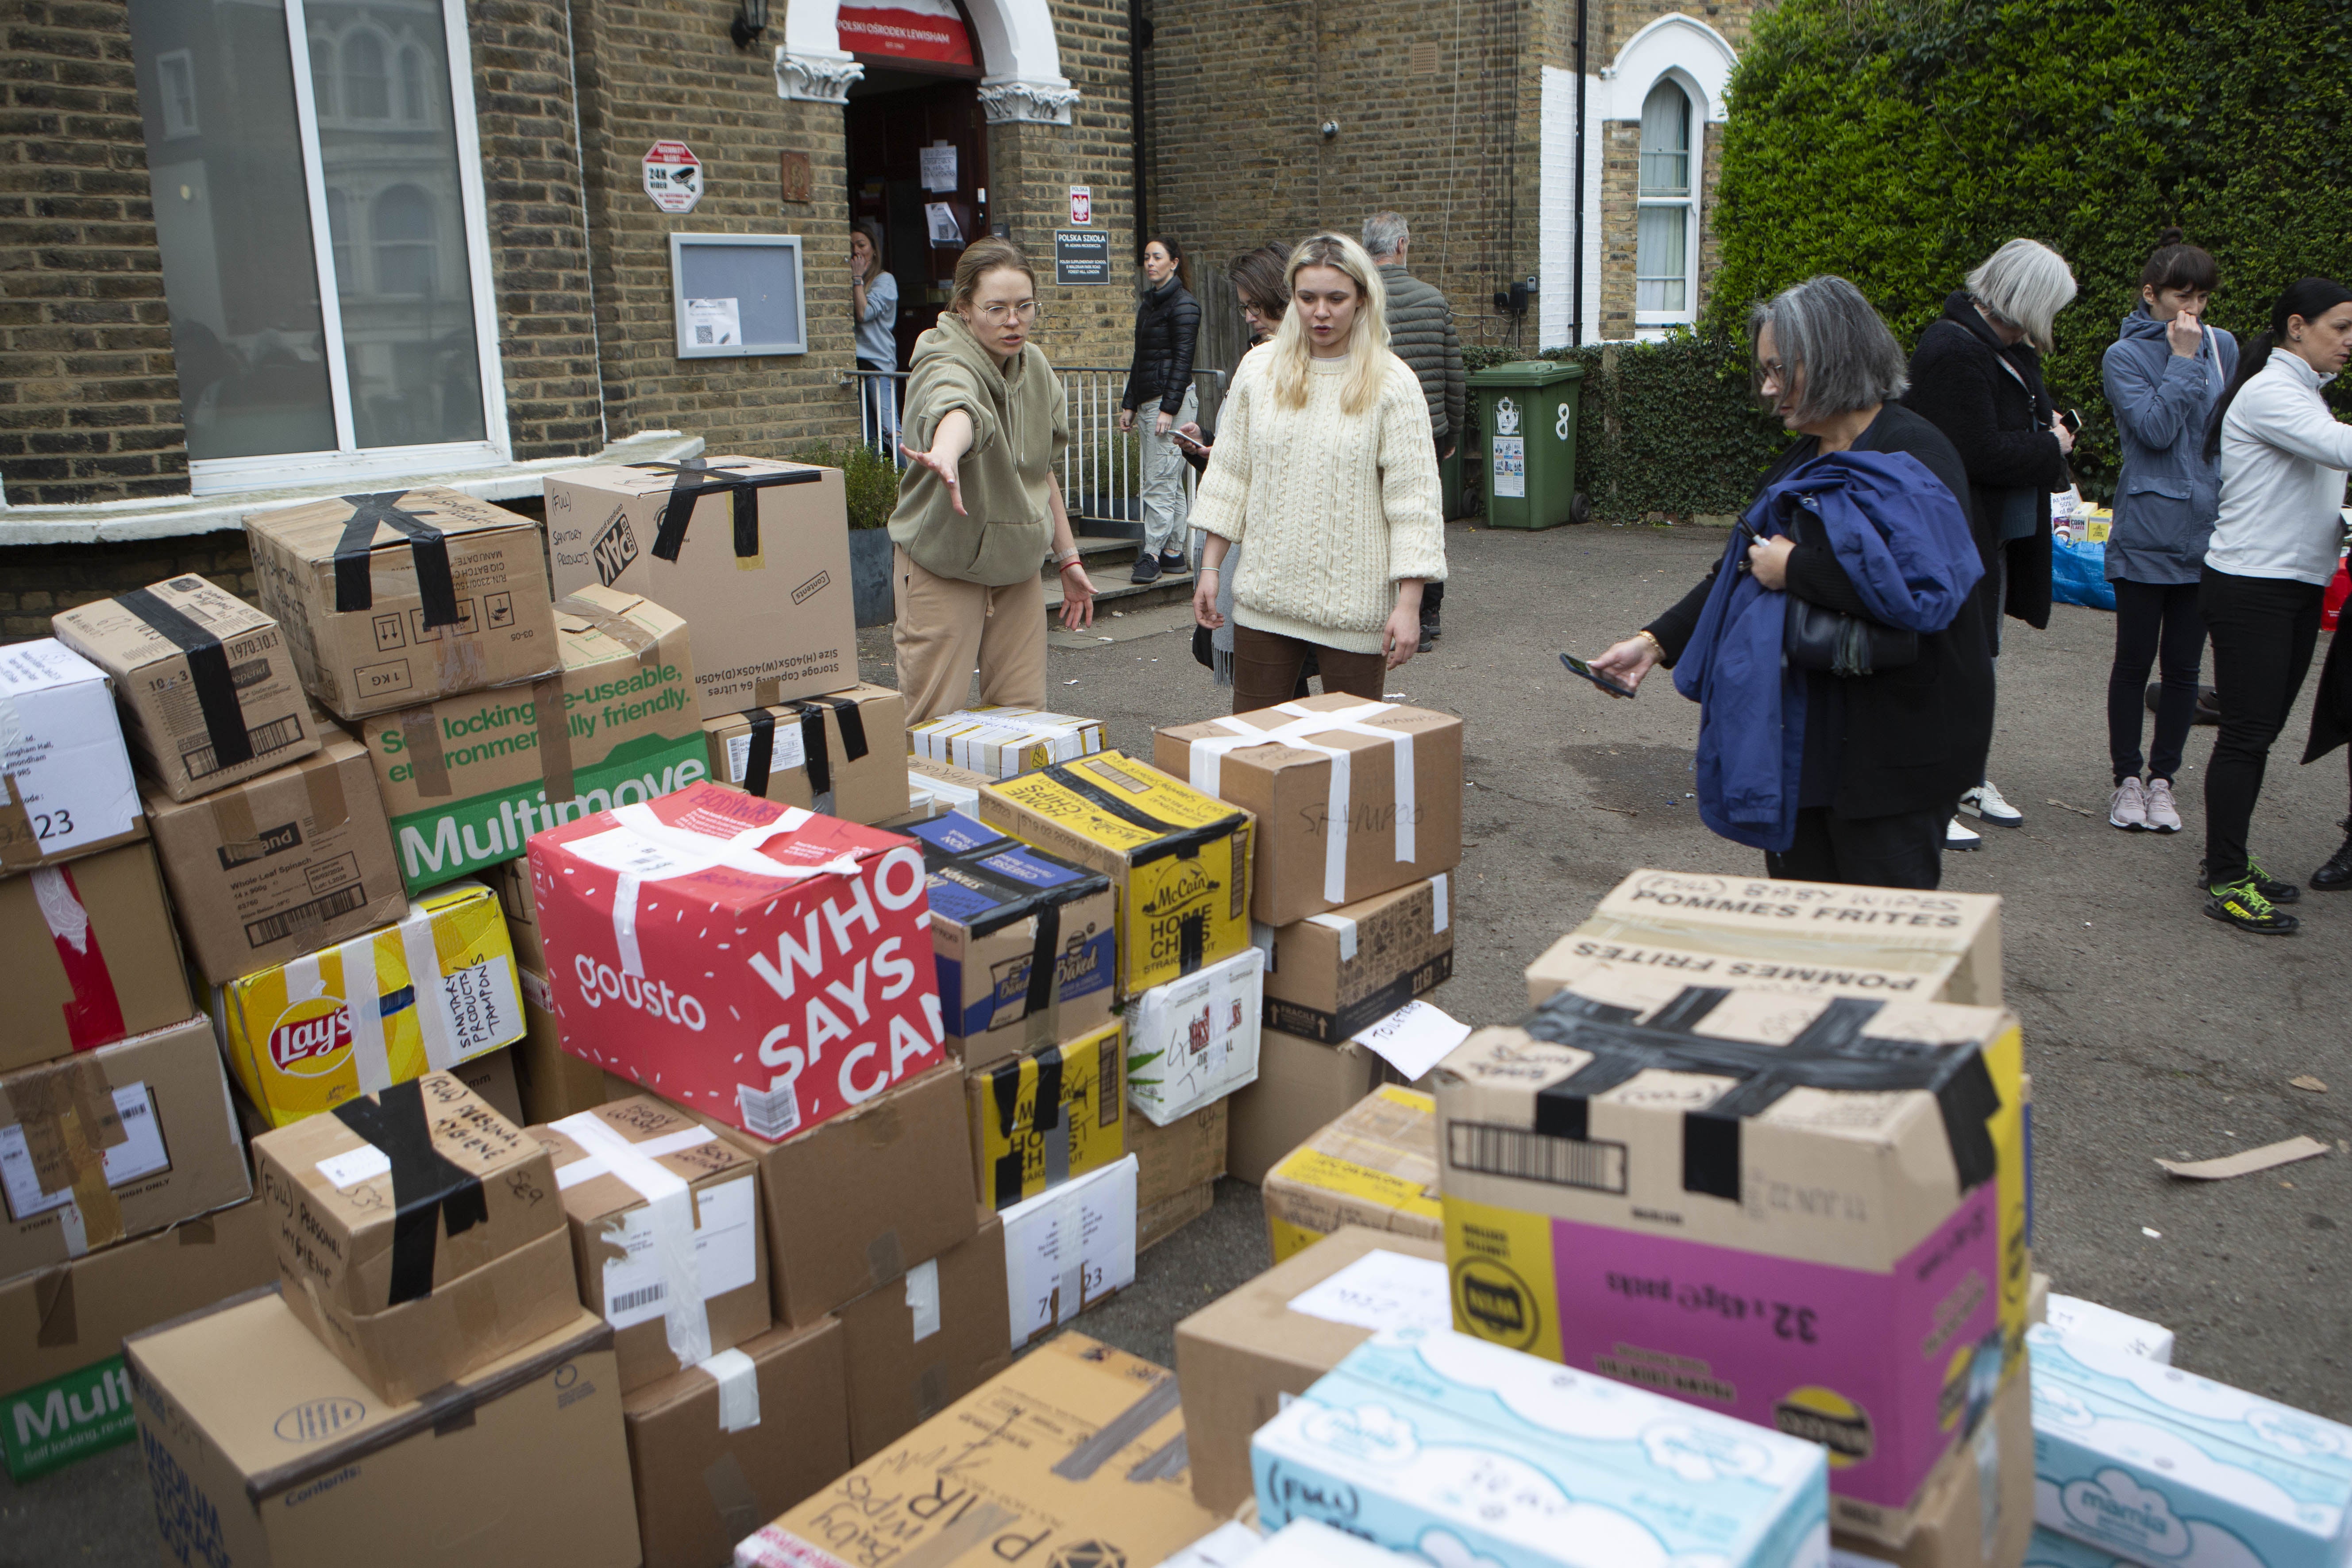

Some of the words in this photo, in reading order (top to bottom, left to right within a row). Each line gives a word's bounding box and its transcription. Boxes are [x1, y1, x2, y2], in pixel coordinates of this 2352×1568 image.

[866, 23, 907, 38] OŚRODEK
[906, 28, 950, 44] LEWISHAM
[1058, 234, 1083, 242] POLSKA
[1083, 234, 1106, 243] SZKOŁA
[1555, 403, 1569, 440] 8
[552, 488, 571, 516] (FULL)
[621, 519, 636, 553] store
[463, 565, 489, 576] BATCH
[480, 550, 503, 561] MANU
[490, 562, 505, 571] CIQ
[595, 527, 631, 587] PAK
[796, 576, 825, 599] Contents
[229, 631, 279, 661] 1970.10.1
[510, 629, 534, 641] 03-05
[818, 648, 838, 660] Size
[149, 677, 165, 691] 10
[179, 670, 188, 681] 3
[232, 663, 266, 684] epend
[372, 674, 391, 686] KG
[740, 681, 753, 691] 64
[802, 663, 839, 678] Storage
[564, 664, 682, 710] e-useable,
[708, 684, 737, 696] Litres
[602, 687, 691, 728] friendly.
[37, 740, 54, 750] Hall,
[1024, 784, 1083, 814] CHIPS
[1041, 778, 1064, 791] CUT
[1006, 789, 1068, 817] HOME
[1299, 802, 1425, 840] SHAMPOO
[230, 876, 258, 891] Whole
[259, 868, 278, 882] Leaf
[278, 857, 312, 874] Spinach
[989, 856, 1038, 881] CHEESE
[250, 885, 267, 896] 900g
[1157, 877, 1205, 909] McCain
[1742, 882, 1843, 904] BABY
[1851, 893, 1964, 912] WIPES
[748, 846, 926, 1001] WHO
[1628, 888, 1802, 919] POMMES
[1812, 902, 1962, 930] FRITES
[1056, 944, 1099, 985] Baked
[1573, 940, 1714, 973] FRITES
[1727, 960, 1919, 991] POMMES
[470, 952, 500, 1036] TAMPONS
[575, 953, 707, 1032] gousto
[443, 974, 471, 1049] SANITARY
[758, 936, 915, 1090] SAYS
[275, 1004, 353, 1069] Lay's
[118, 1187, 143, 1201] HIGH
[145, 1178, 170, 1196] ONLY
[300, 1200, 343, 1261] PERSONAL
[281, 1222, 332, 1291] HYGIENE
[1604, 1270, 1673, 1305] packs
[1770, 1302, 1820, 1346] 32
[12, 1367, 135, 1445] Mult
[285, 1465, 363, 1507] Contents:
[2079, 1488, 2168, 1534] mamia
